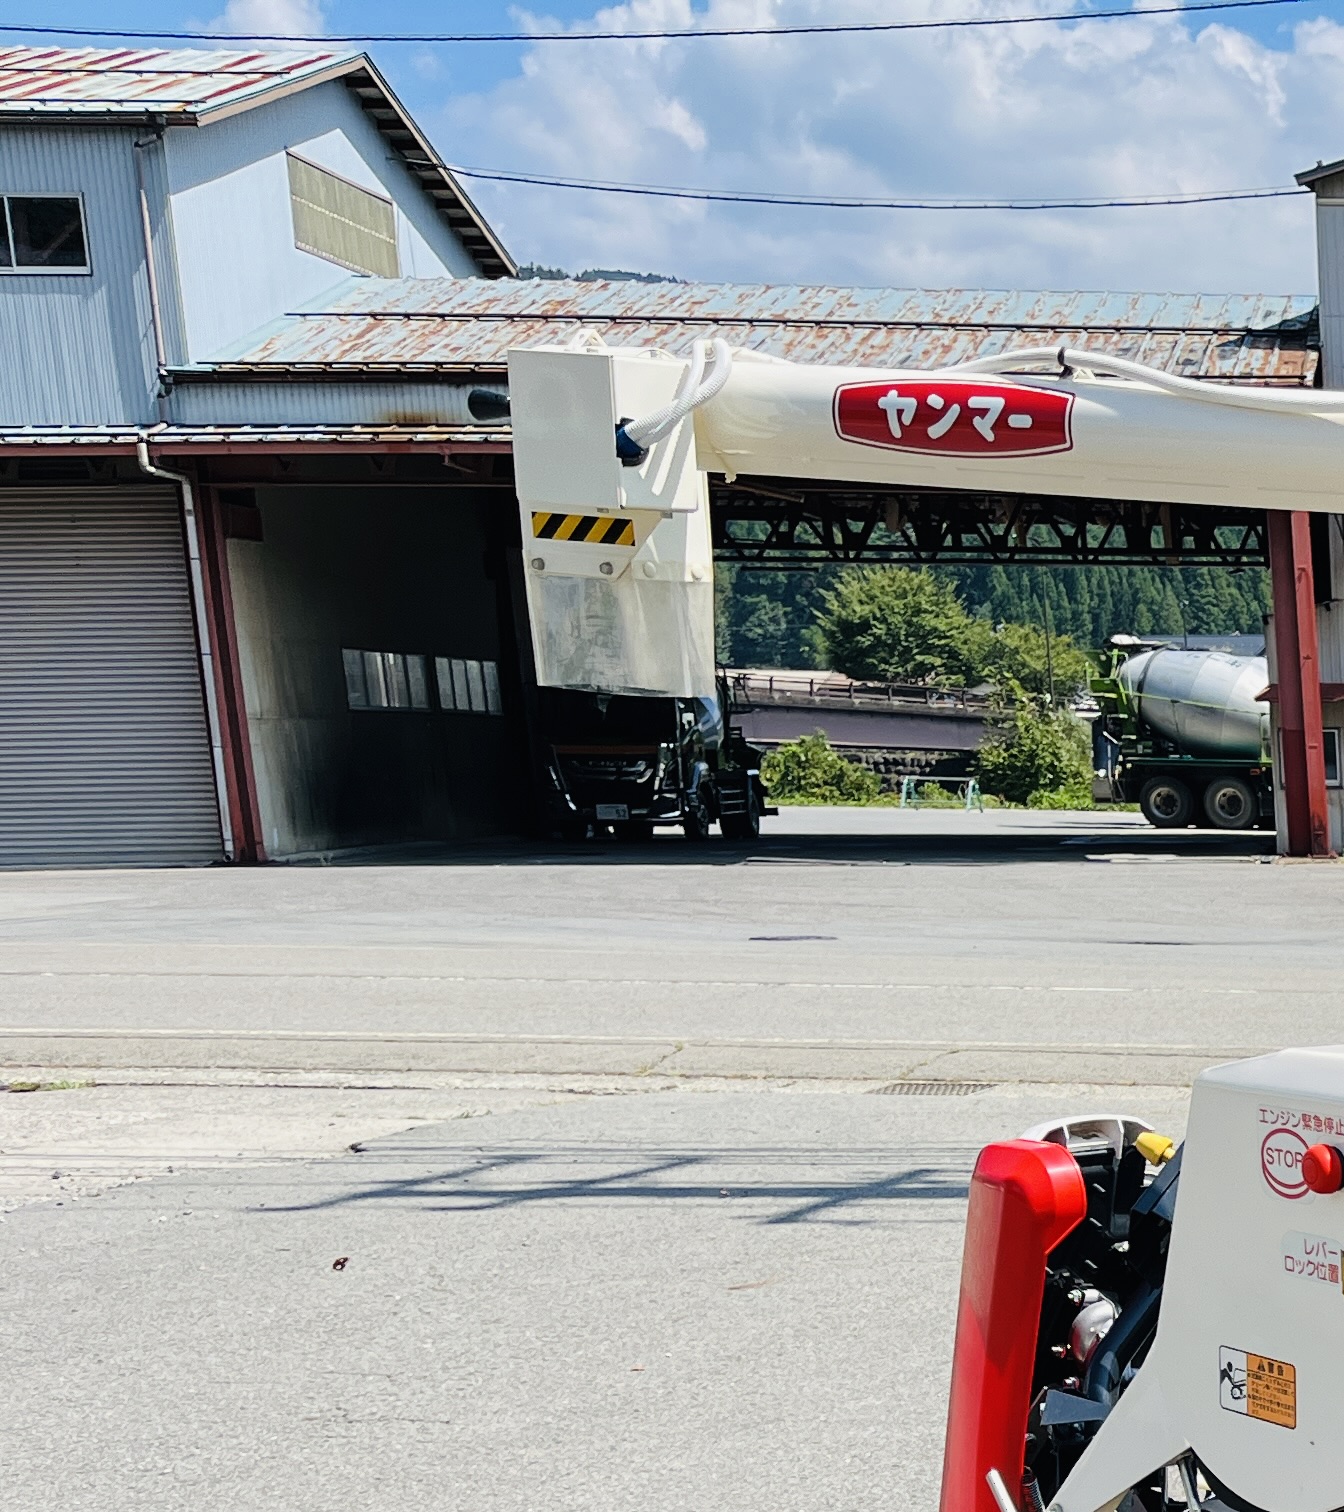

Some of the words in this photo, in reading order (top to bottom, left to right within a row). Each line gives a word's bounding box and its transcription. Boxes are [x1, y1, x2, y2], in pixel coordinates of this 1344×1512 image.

[877, 389, 1033, 443] ヤンマー
[1265, 1147, 1304, 1169] STOP
[1303, 1238, 1338, 1259] レバー
[1284, 1255, 1339, 1284] ロック位置
